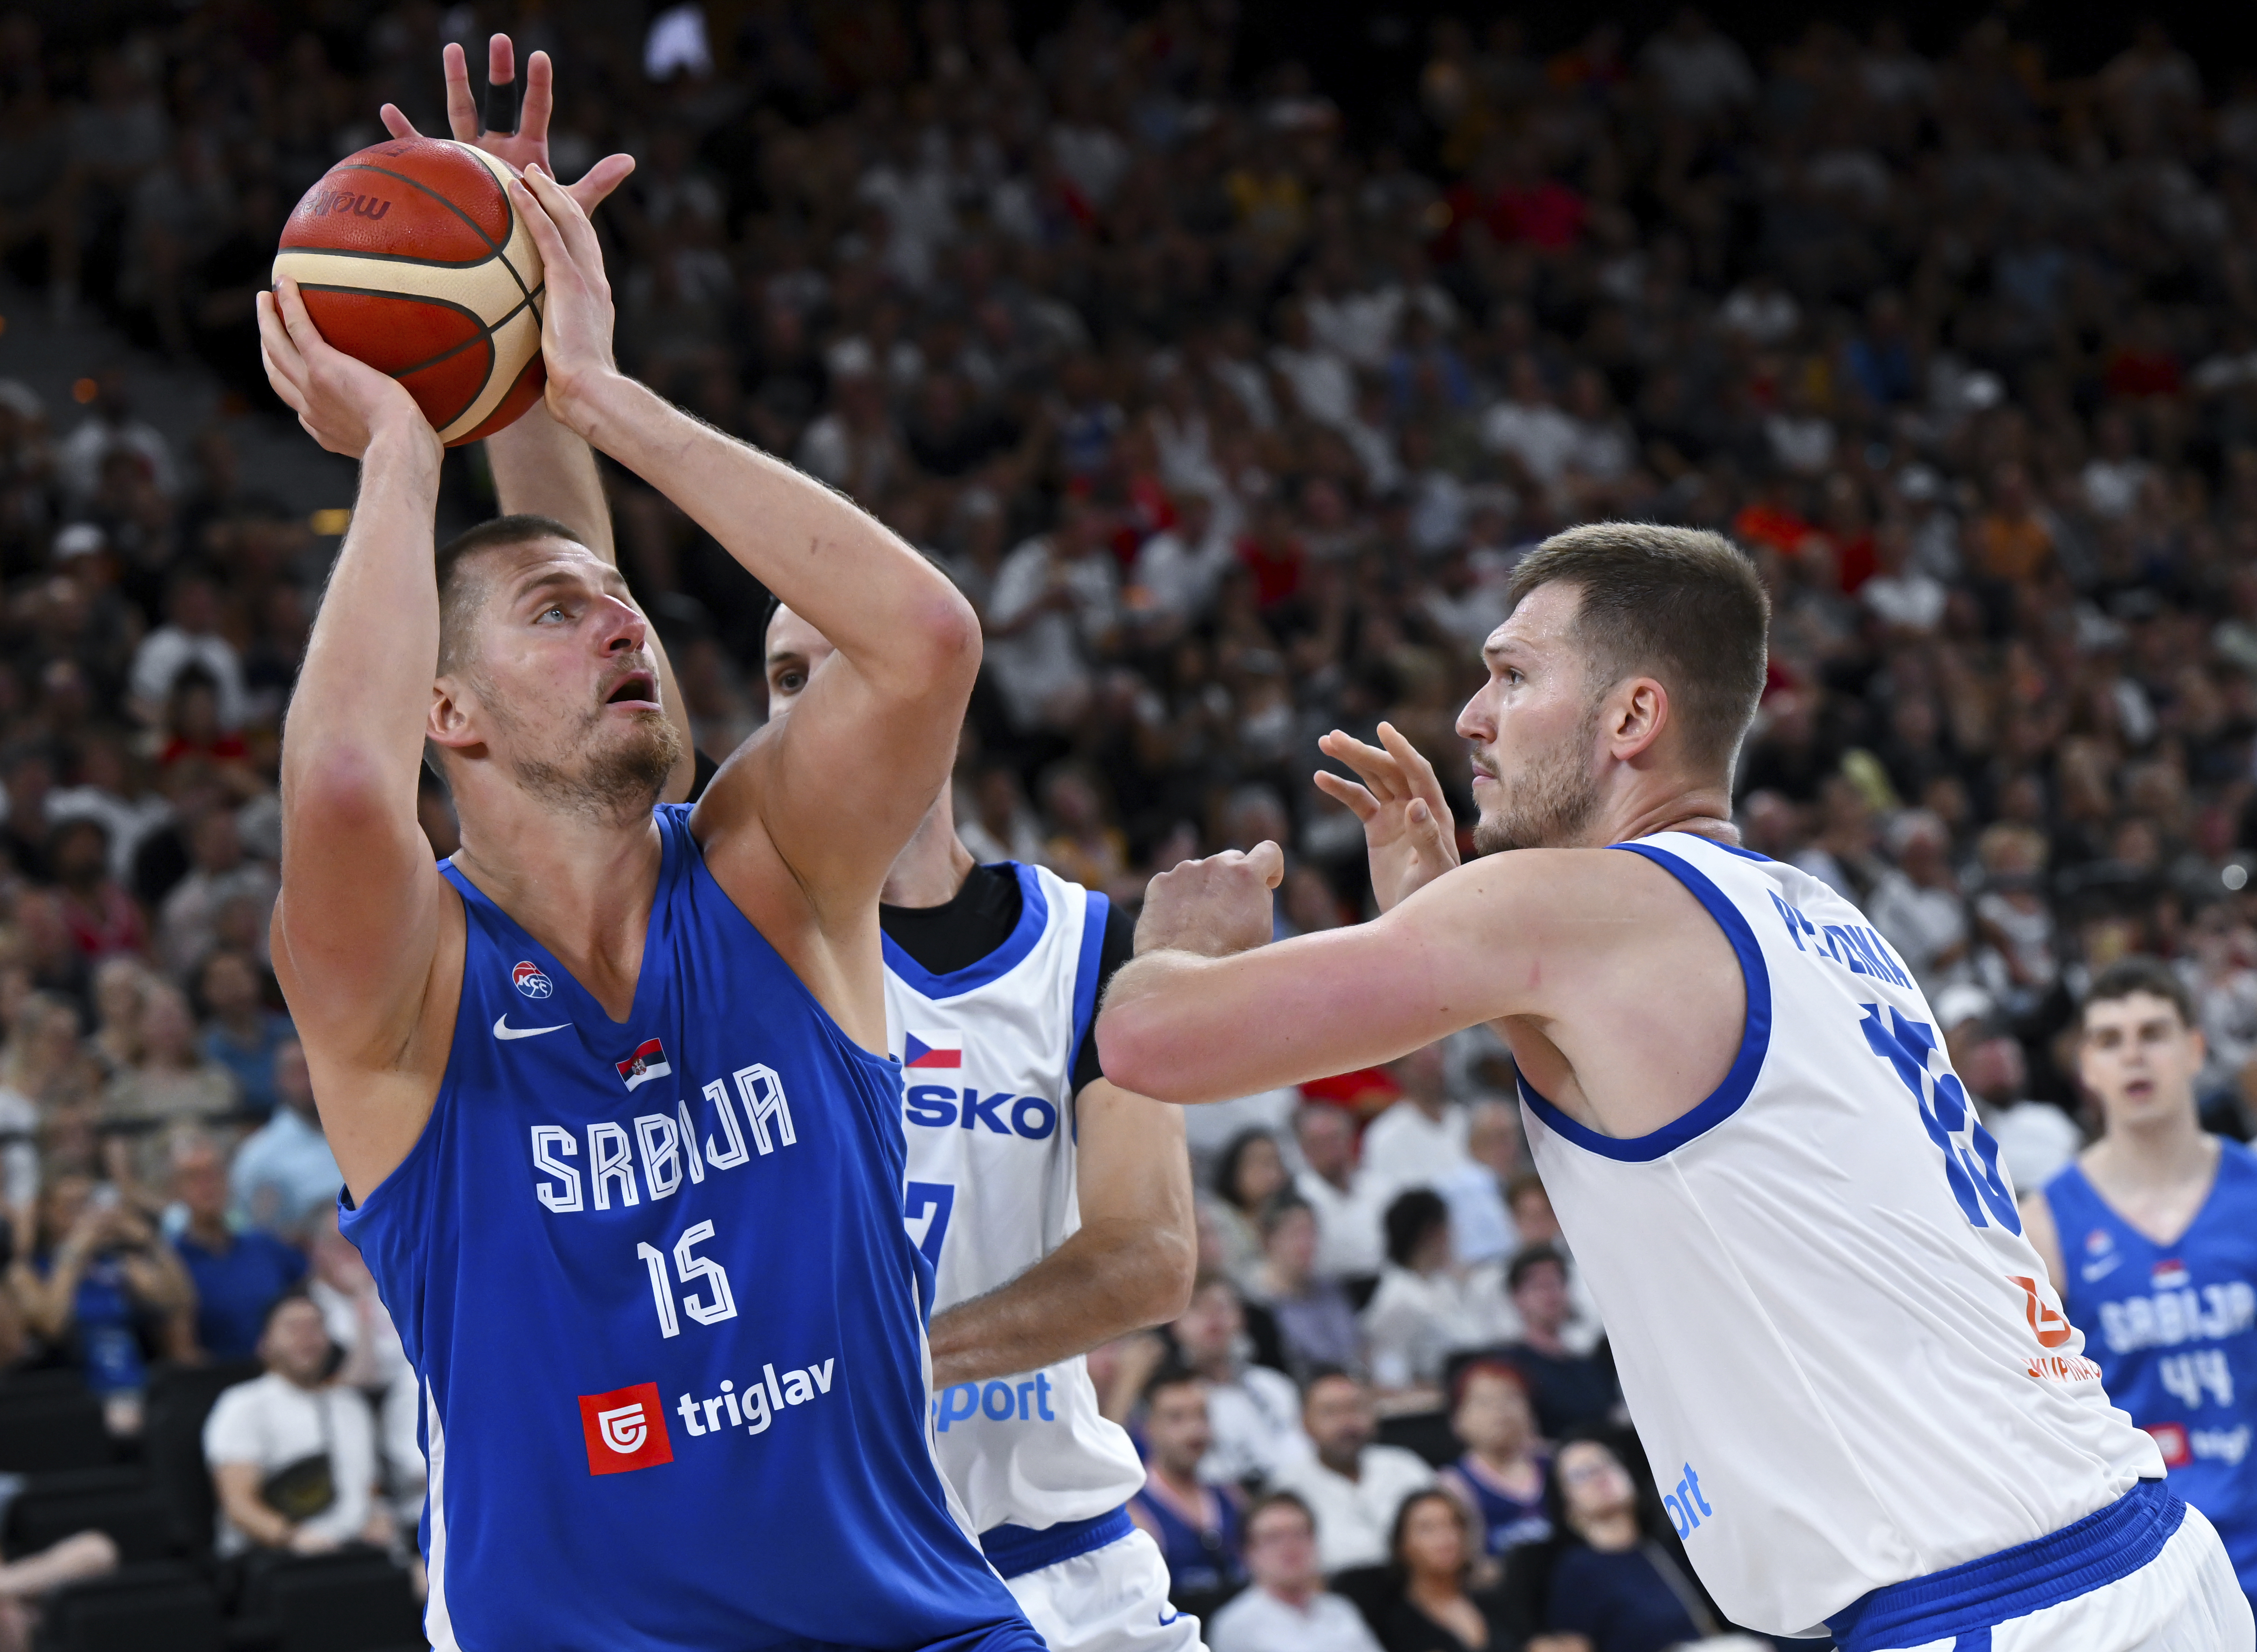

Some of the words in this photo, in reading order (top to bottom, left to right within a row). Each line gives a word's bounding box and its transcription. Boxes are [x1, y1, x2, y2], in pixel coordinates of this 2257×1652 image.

[531, 1063, 797, 1213] SRBIJA
[902, 1083, 1056, 1140] SKO
[637, 1219, 738, 1339] 15
[677, 1357, 834, 1436] triglav
[932, 1372, 1055, 1432] port
[2158, 1349, 2235, 1409] 44
